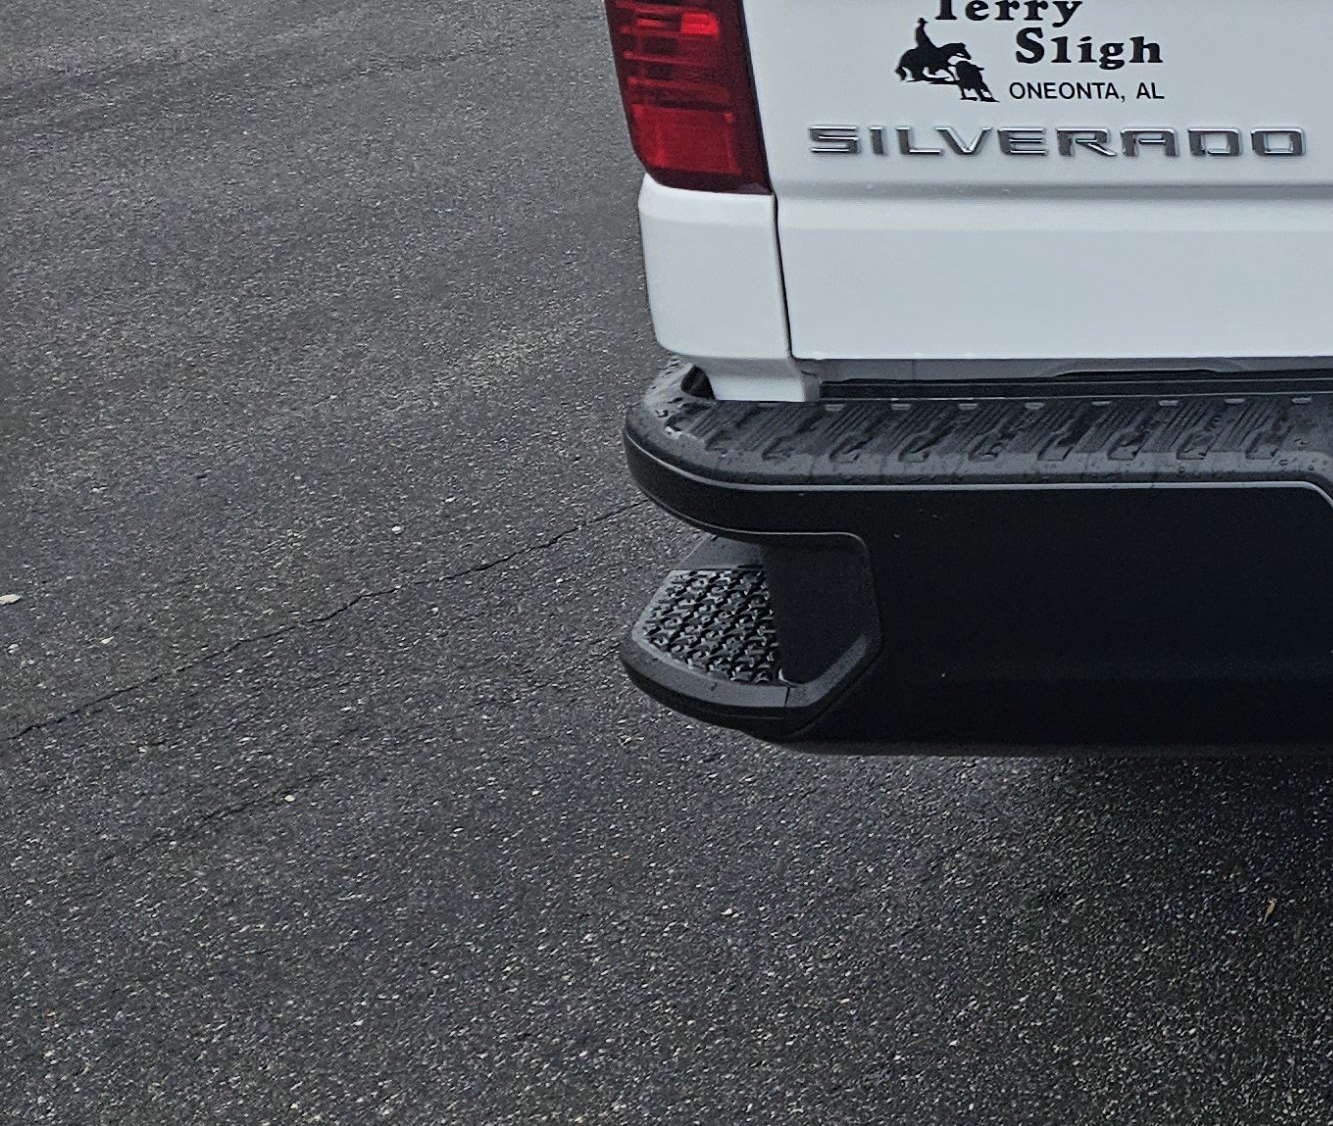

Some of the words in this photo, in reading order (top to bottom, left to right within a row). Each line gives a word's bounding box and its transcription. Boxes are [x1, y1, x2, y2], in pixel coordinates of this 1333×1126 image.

[1016, 27, 1163, 70] Sligh
[1009, 81, 1126, 101] ONEONTA,
[1136, 82, 1165, 100] AL
[808, 126, 1306, 158] SILVERADO
